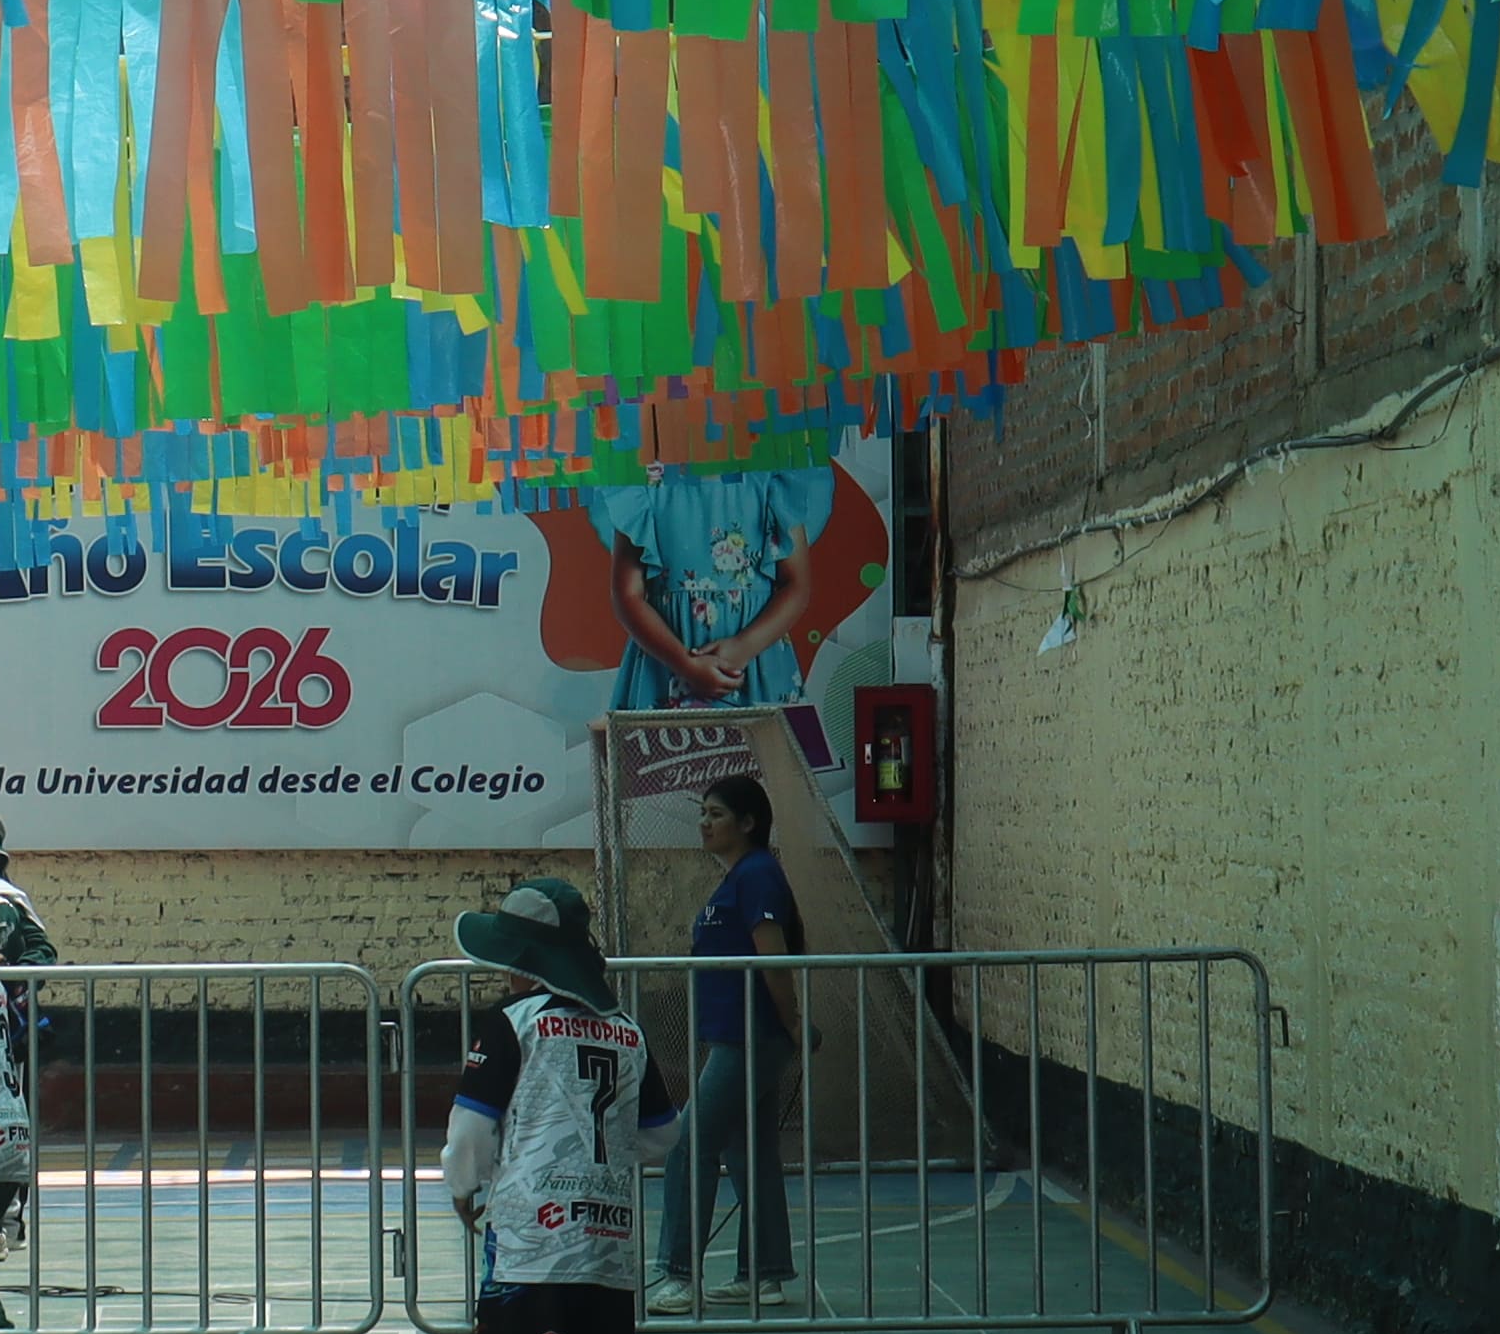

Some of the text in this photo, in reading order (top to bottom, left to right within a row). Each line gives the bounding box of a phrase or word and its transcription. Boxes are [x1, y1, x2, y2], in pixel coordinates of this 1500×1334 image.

[97, 627, 353, 728] 2026
[37, 765, 249, 795] Universidad
[258, 765, 361, 793] desde
[370, 765, 401, 793] el
[411, 764, 545, 800] Colegio
[576, 1044, 619, 1165] 7
